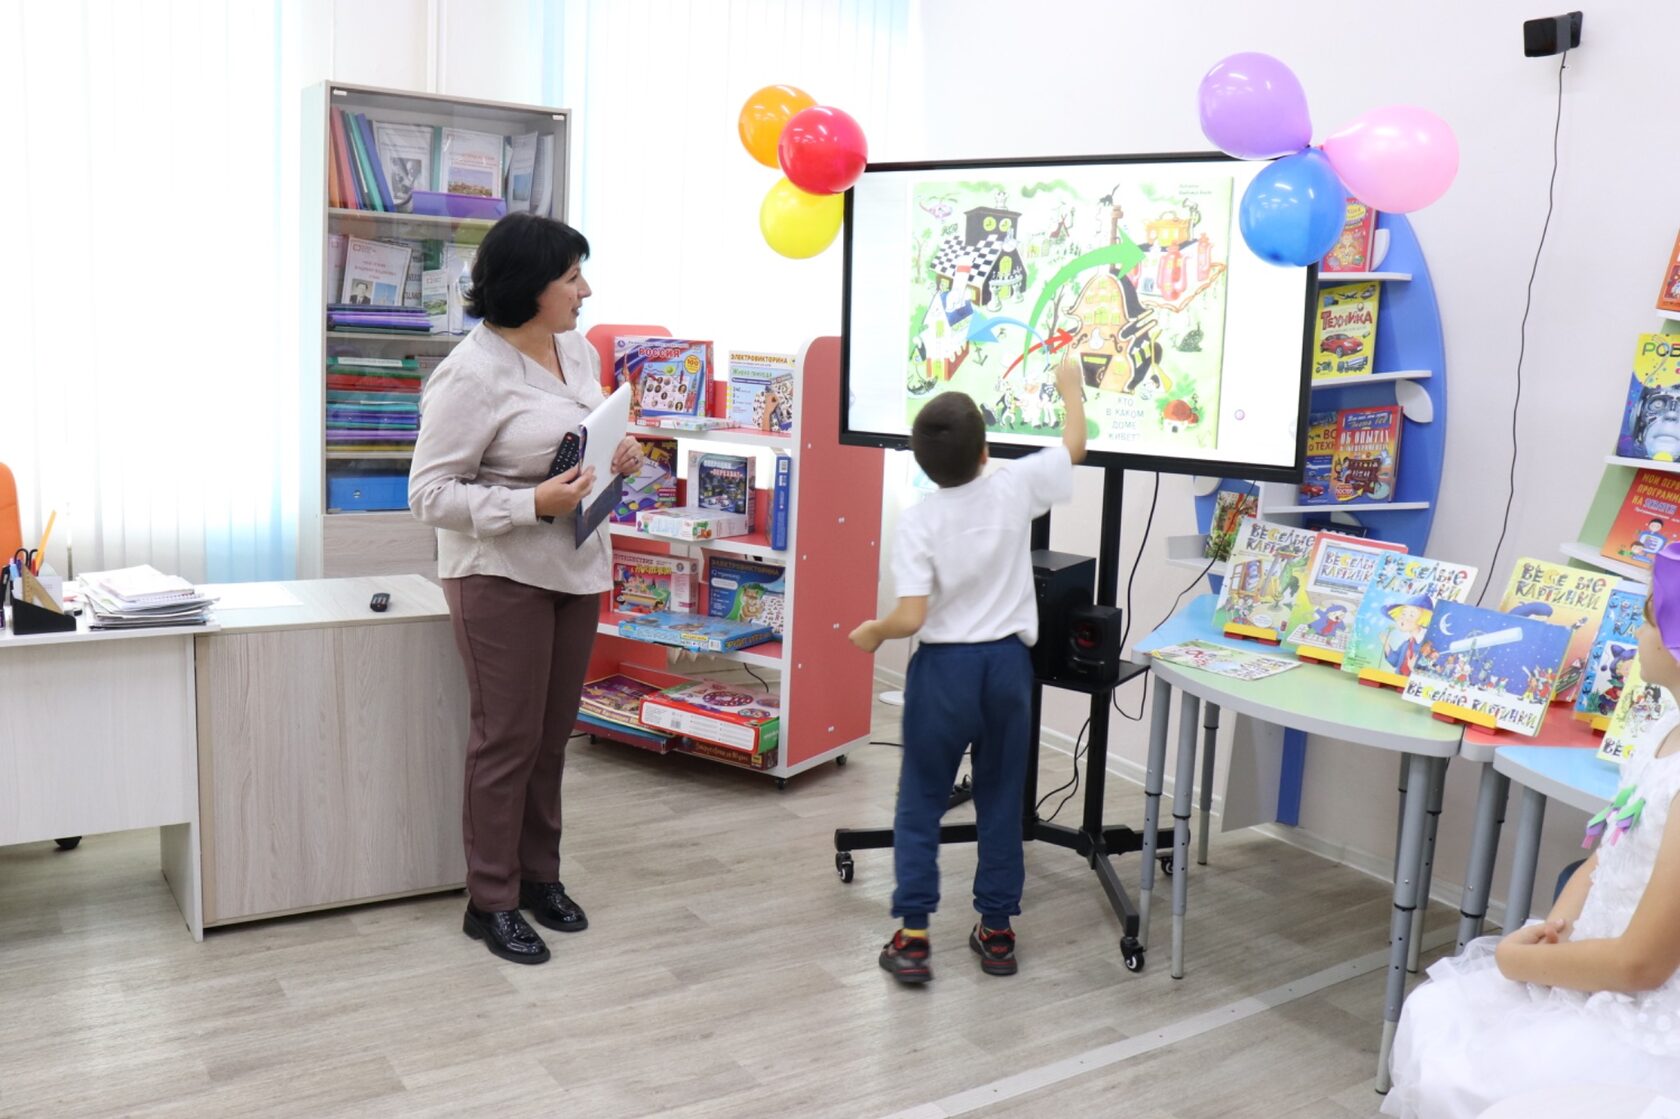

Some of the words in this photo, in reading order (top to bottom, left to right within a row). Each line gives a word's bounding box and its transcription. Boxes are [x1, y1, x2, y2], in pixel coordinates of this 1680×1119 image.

[639, 347, 681, 358] РОССИЯ
[730, 353, 788, 364] ЭЛЕКТРОВИКТОРИНА
[1515, 580, 1601, 611] КАРТИНКИ
